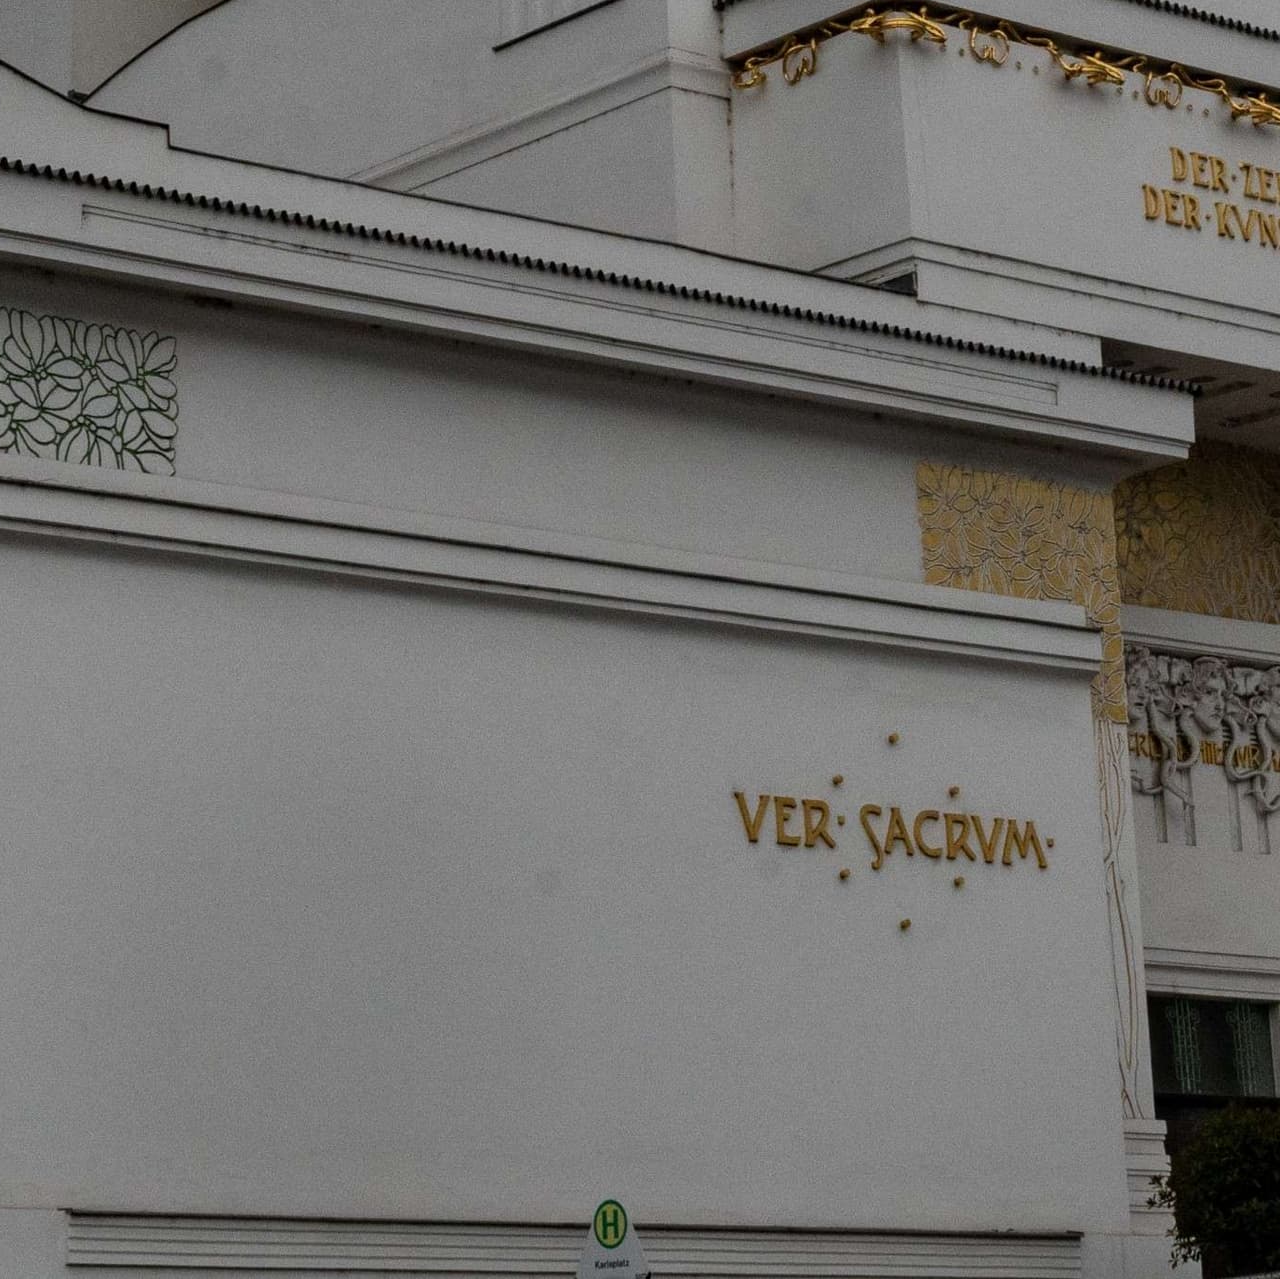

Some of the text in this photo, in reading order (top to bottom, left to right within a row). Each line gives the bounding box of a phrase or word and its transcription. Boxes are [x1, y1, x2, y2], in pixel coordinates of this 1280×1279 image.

[1170, 146, 1229, 193] DER
[1141, 183, 1201, 230] DER
[601, 1208, 620, 1240] H
